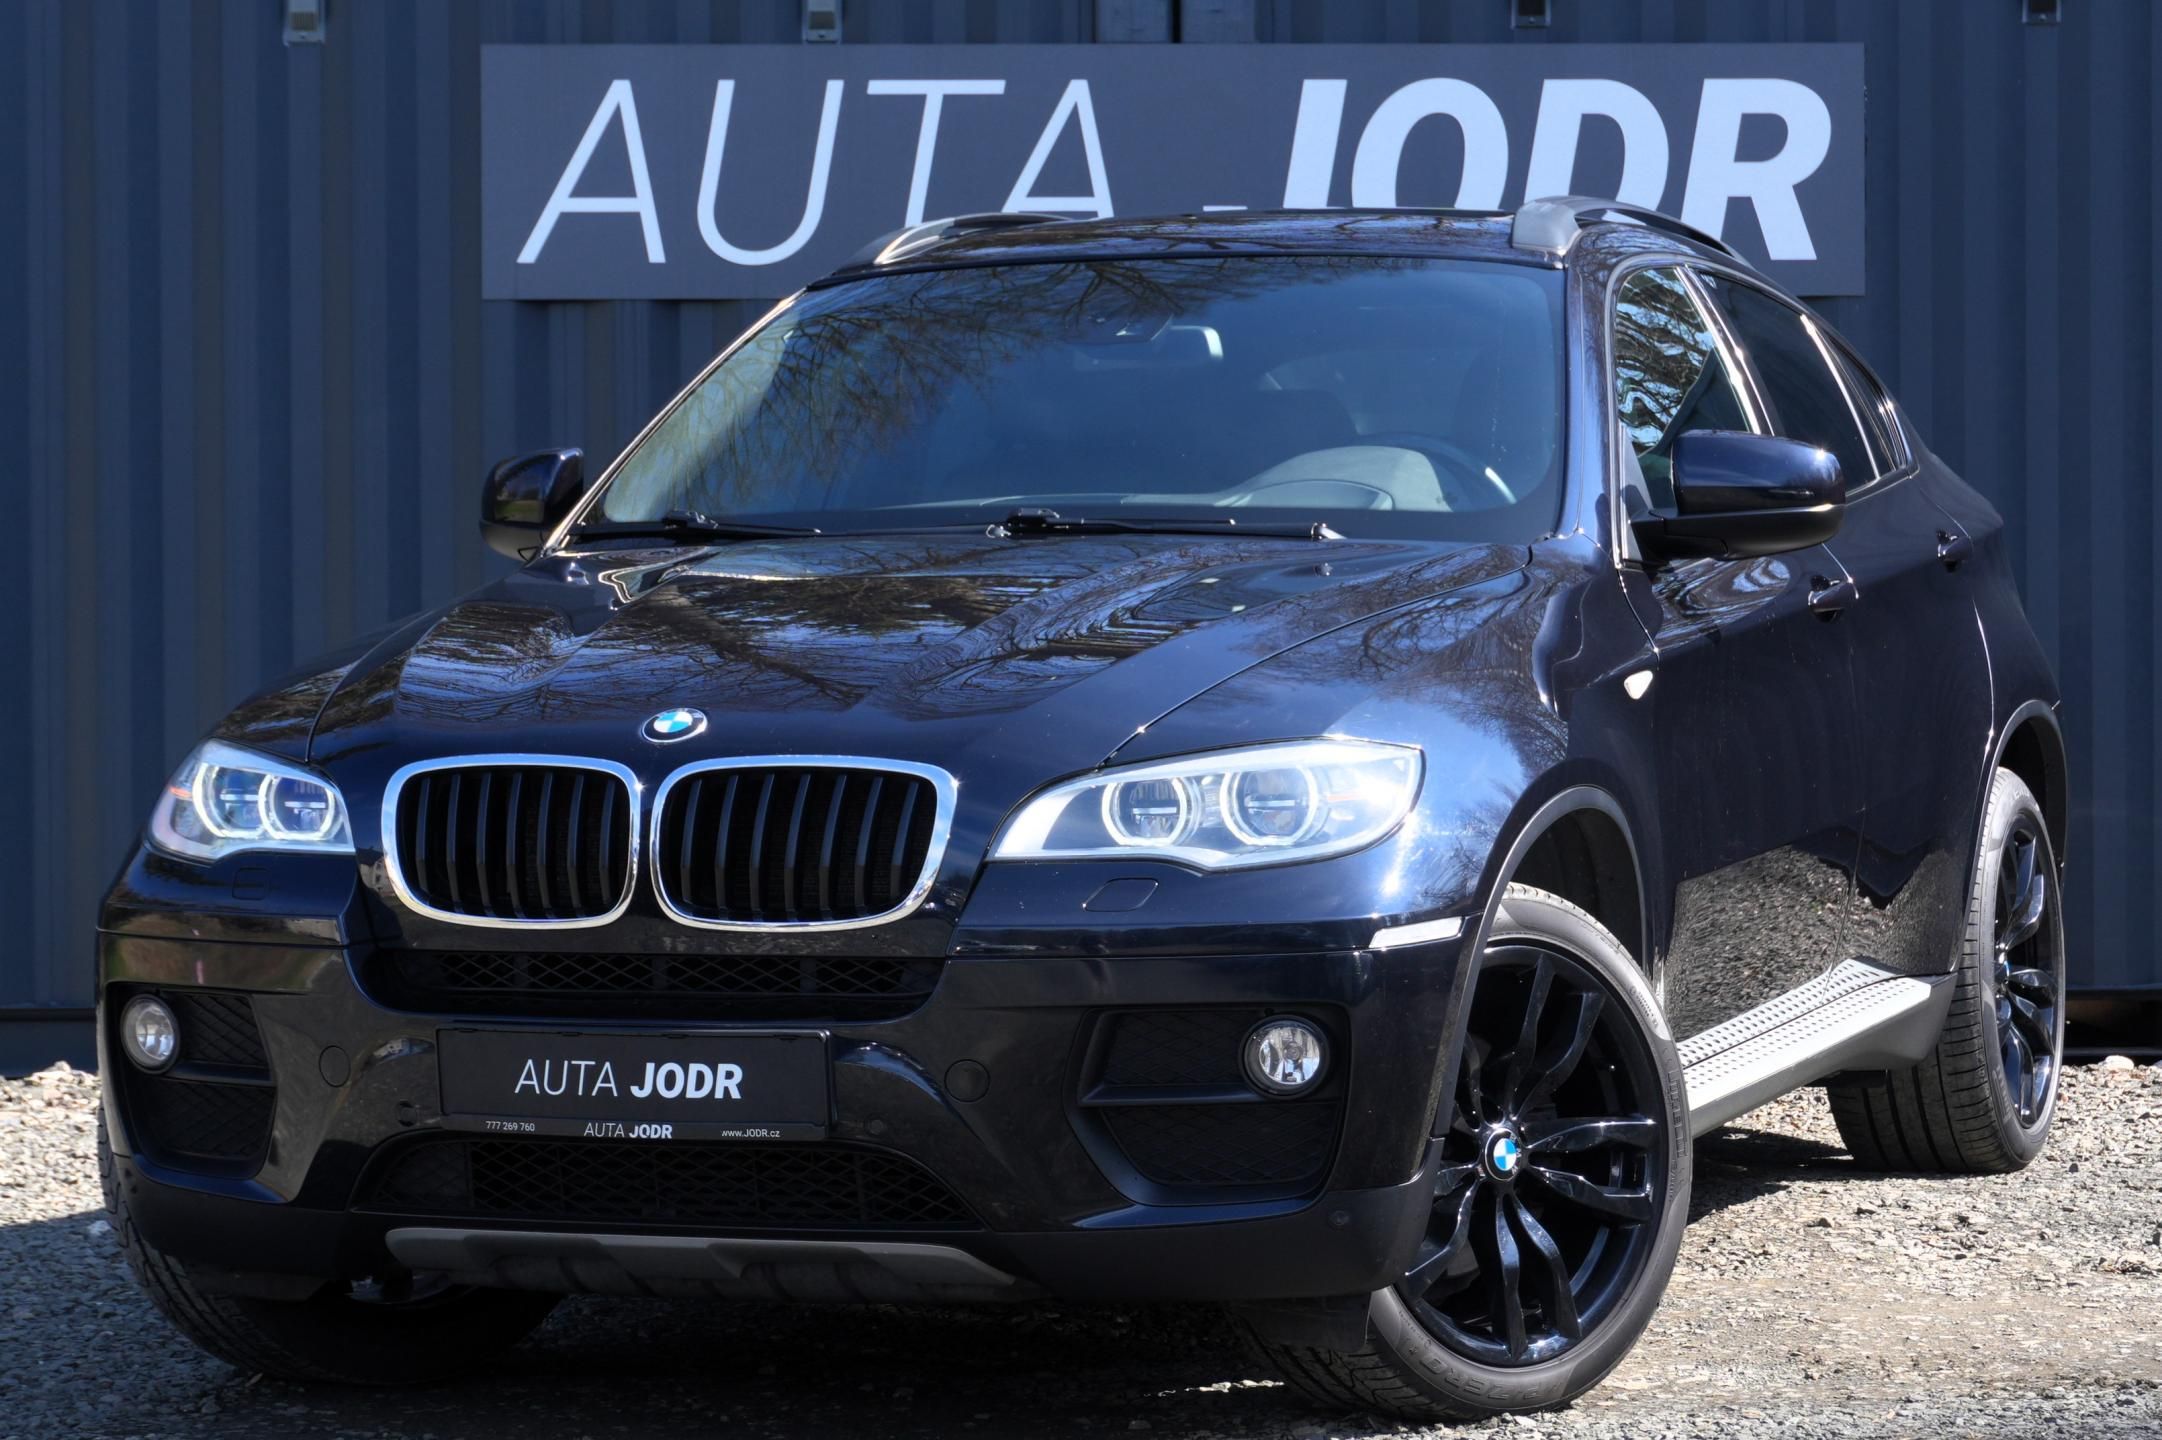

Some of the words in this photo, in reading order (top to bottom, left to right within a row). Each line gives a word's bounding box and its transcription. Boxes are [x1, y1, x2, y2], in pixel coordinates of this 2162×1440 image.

[516, 79, 1114, 266] AUTA
[514, 1058, 618, 1097] AUTA
[630, 1062, 743, 1100] JODR
[486, 1120, 500, 1130] 777
[503, 1122, 518, 1132] 269
[520, 1122, 535, 1132] 760
[584, 1122, 625, 1138] AUTA
[629, 1124, 672, 1139] JODR
[721, 1128, 781, 1138] www.JODR.cz
